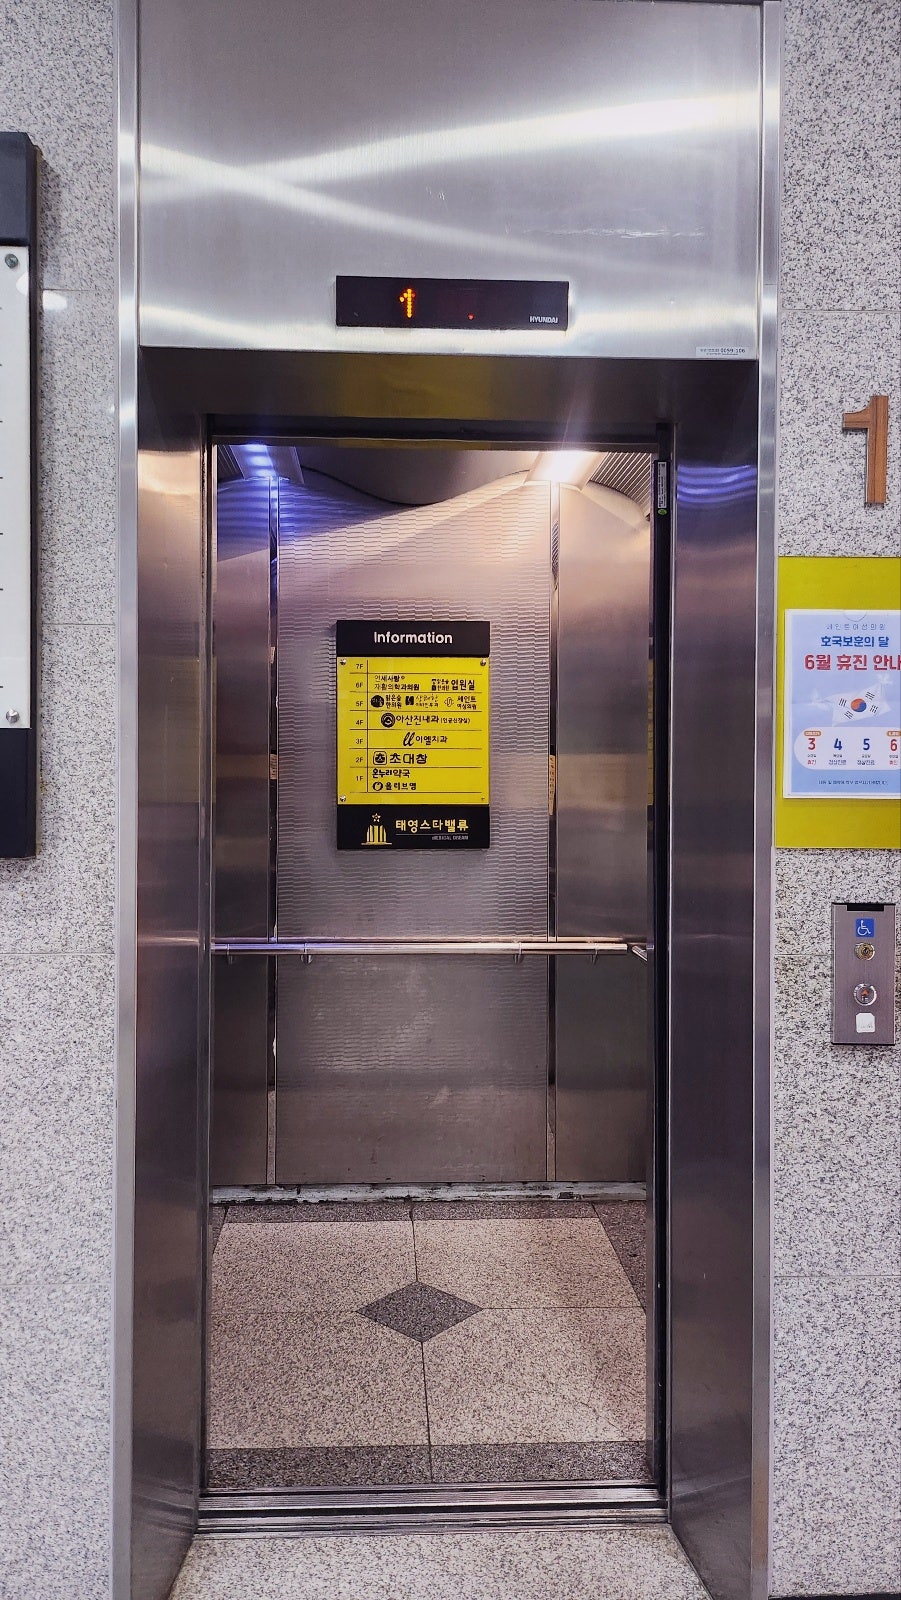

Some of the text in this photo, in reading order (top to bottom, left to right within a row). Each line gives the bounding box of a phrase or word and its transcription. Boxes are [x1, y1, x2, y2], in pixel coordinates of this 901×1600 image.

[530, 316, 558, 324] HYUNDAI
[842, 396, 889, 503] 1
[374, 631, 453, 644] Information
[820, 635, 890, 647] 호국보훈의 달
[804, 654, 831, 671] 6월
[836, 654, 867, 671] 휴진
[451, 679, 475, 691] 입원실
[385, 701, 402, 709] 한의원
[457, 695, 477, 703] 세인트
[396, 715, 439, 726] 아산진내과
[416, 735, 448, 745] 이엘치과
[808, 738, 816, 750] 3
[834, 738, 842, 750] 4
[863, 738, 870, 750] 5
[890, 739, 898, 751] 6
[390, 752, 427, 764] 초대창
[372, 768, 411, 778] 온누리약국
[395, 819, 469, 833] 태영스타밸류
